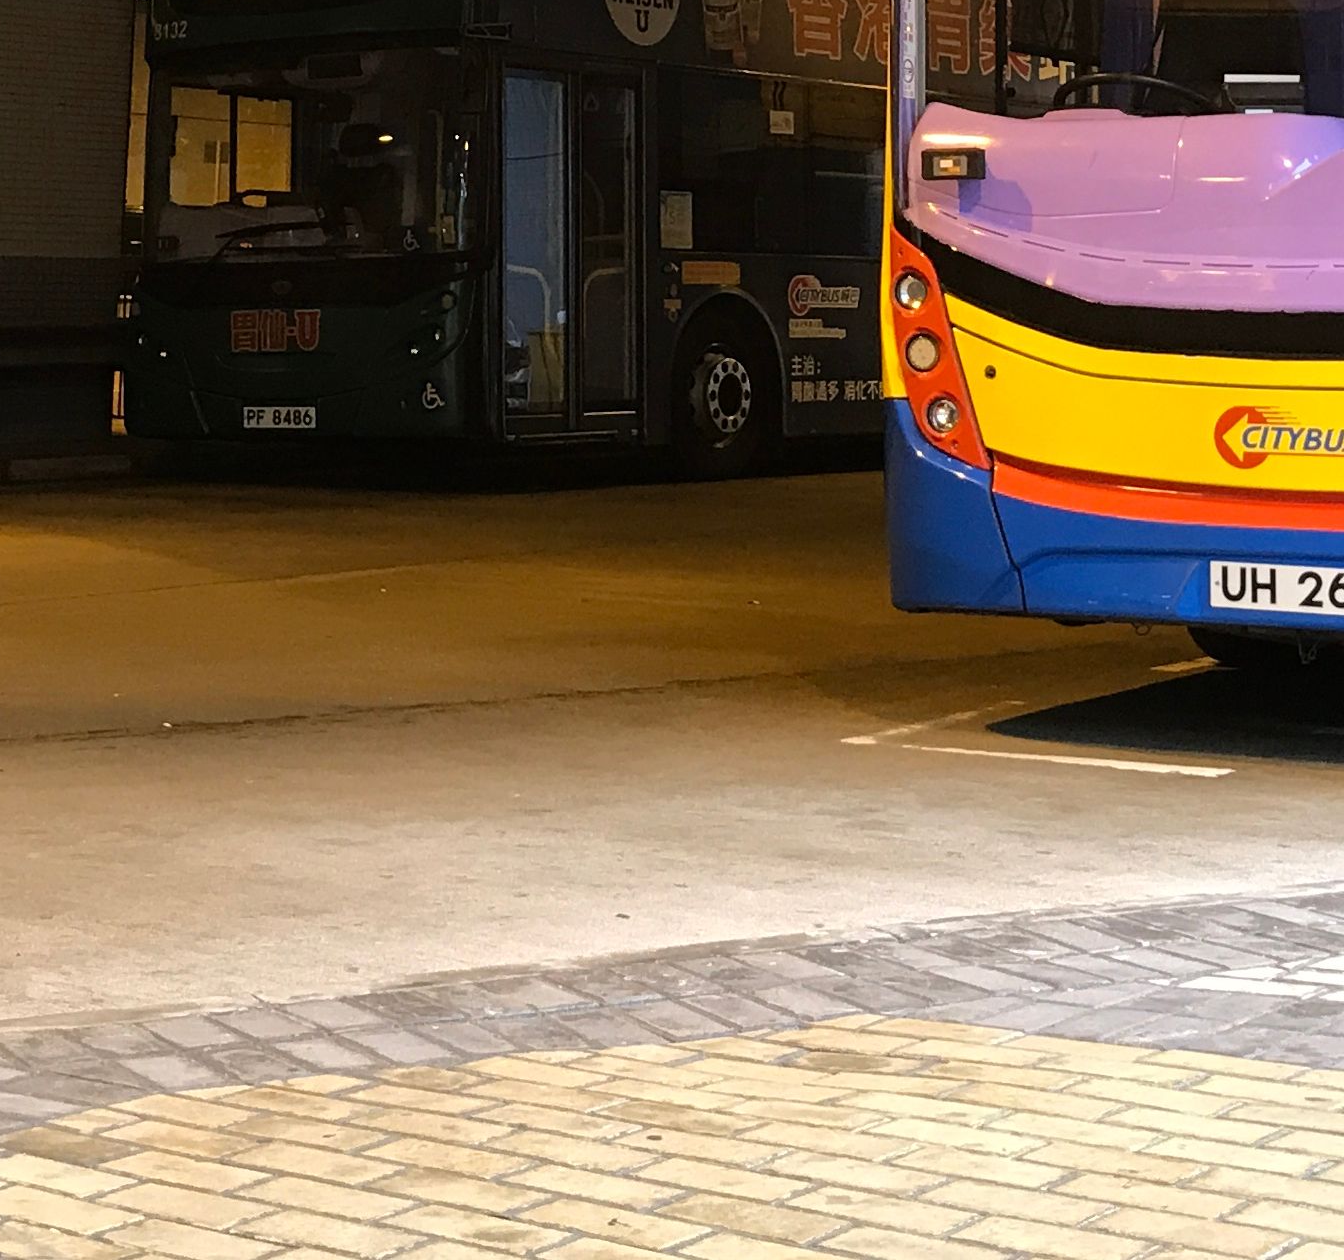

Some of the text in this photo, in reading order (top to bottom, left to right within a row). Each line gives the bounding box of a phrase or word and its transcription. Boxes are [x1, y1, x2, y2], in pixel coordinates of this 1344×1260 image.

[154, 20, 188, 41] 8132
[634, 9, 651, 33] U
[230, 308, 321, 352] 胃仙-U
[246, 408, 313, 426] PF 8486
[1221, 565, 1277, 605] UH
